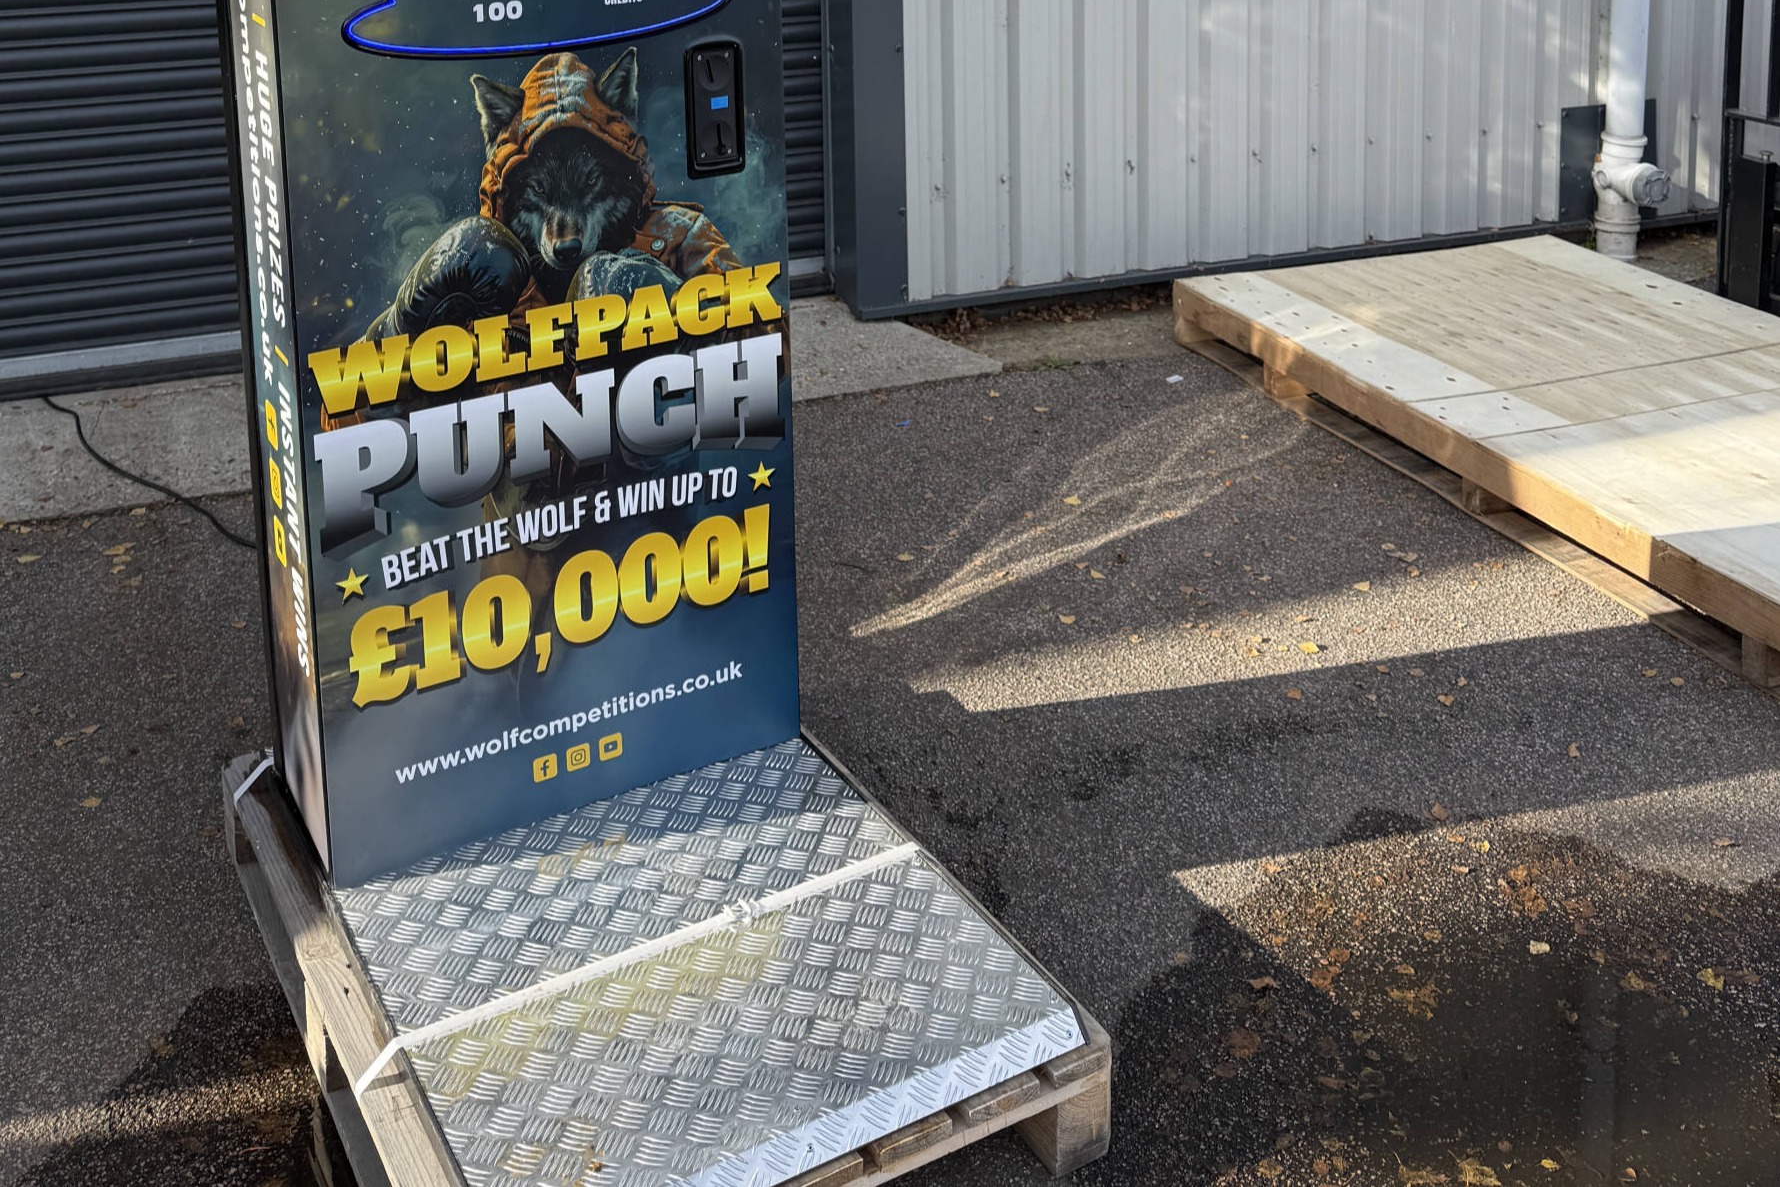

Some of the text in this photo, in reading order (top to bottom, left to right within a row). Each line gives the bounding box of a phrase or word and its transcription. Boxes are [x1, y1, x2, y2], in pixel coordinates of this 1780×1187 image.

[472, 0, 523, 22] 100
[255, 50, 274, 167] HUGE
[264, 175, 285, 328] PRIZES
[307, 262, 785, 414] WOLFPACK
[278, 380, 302, 564] INSTANT
[313, 333, 785, 553] PUNCH
[381, 466, 738, 590] BEAT THE WOLF & WIN UP TO
[291, 566, 310, 677] WINS
[349, 503, 771, 709] £10,000!
[395, 660, 744, 784] www.wolfcompetitions.co.uk
